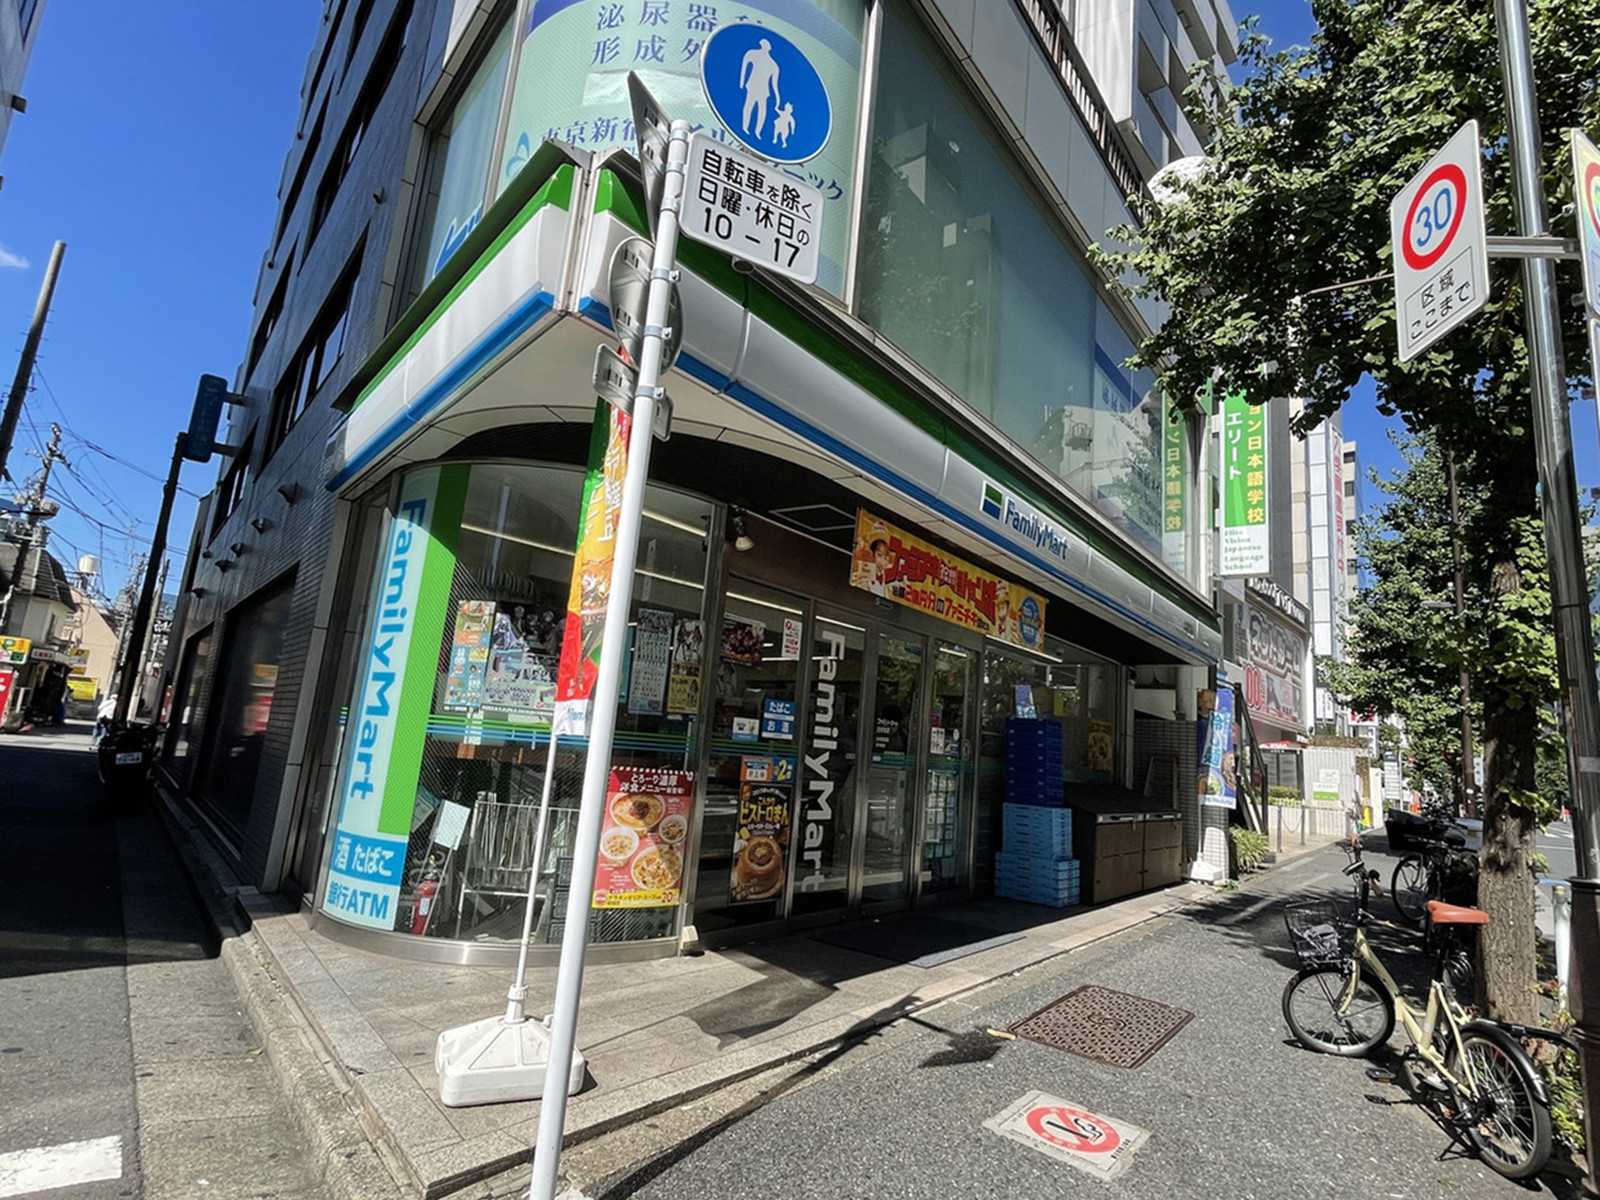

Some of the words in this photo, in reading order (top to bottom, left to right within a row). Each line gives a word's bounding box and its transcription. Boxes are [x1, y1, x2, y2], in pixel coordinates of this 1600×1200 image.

[597, 0, 764, 32] 泌尿器
[698, 176, 811, 247] 日曜・休日の
[702, 148, 813, 220] 自転車を除く
[1416, 187, 1452, 247] 30
[1411, 281, 1471, 340] ここまで
[1421, 268, 1454, 309] 区域
[1226, 411, 1243, 481] エリート
[1004, 498, 1068, 560] FamilyMart
[350, 498, 427, 800] FamilyMart
[769, 700, 791, 714] たばこ
[801, 630, 846, 893] FamilyMart
[740, 800, 789, 825] ビストロまん
[351, 843, 395, 877] たばこ
